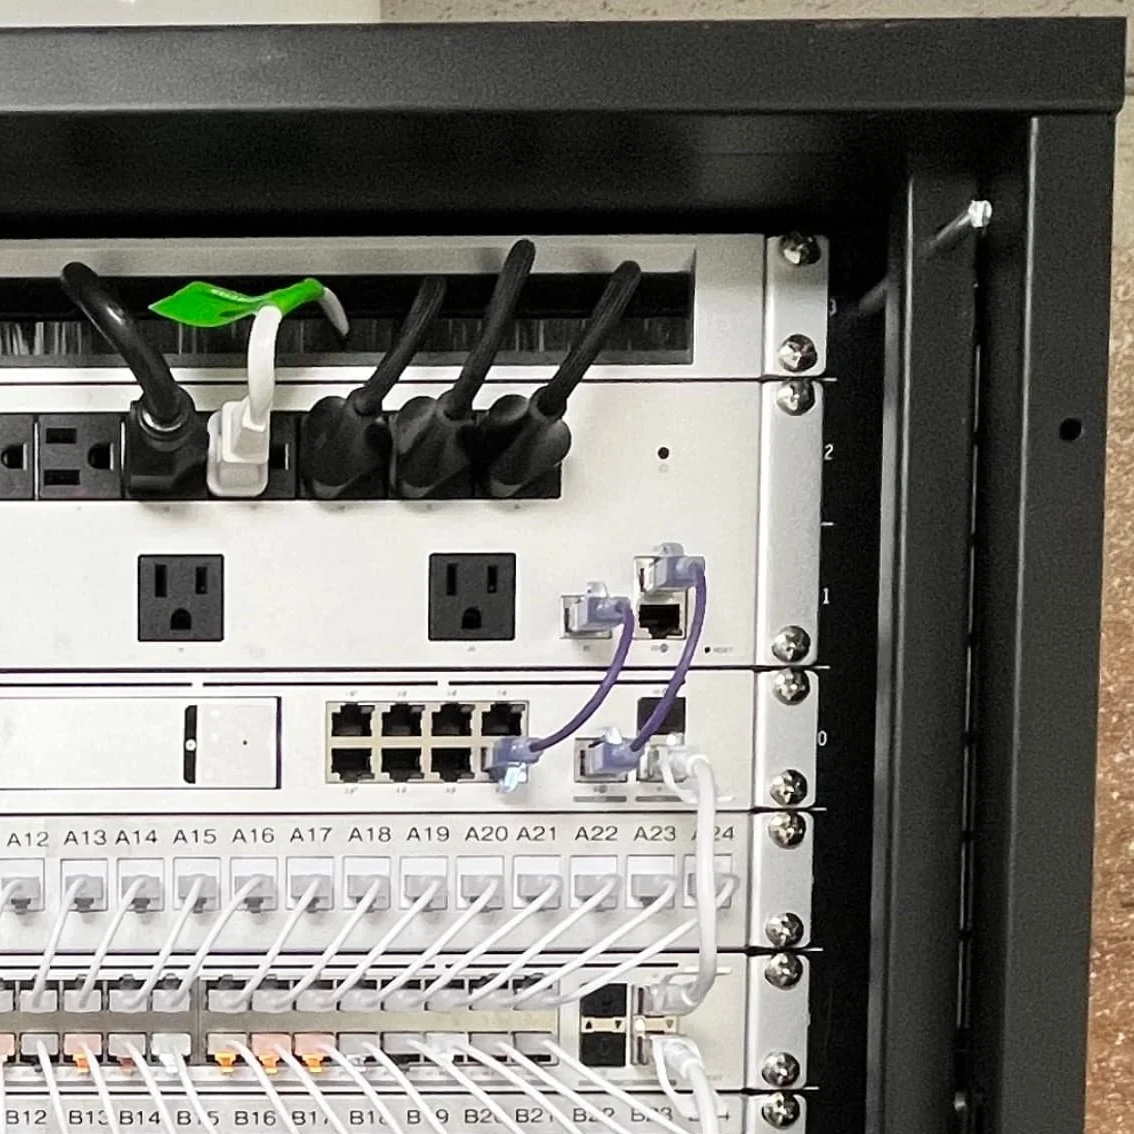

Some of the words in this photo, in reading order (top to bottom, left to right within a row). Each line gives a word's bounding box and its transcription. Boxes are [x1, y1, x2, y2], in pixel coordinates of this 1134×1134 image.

[823, 443, 834, 461] 2
[822, 587, 831, 605] 1
[6, 831, 50, 848] A12
[63, 828, 108, 846] A13
[114, 829, 158, 846] A14
[172, 828, 217, 845] A15
[231, 826, 275, 844] A16
[289, 826, 333, 843] A17
[347, 826, 392, 843] A18
[406, 825, 450, 843] A19
[464, 825, 509, 842] A20
[516, 825, 558, 842] A21
[574, 825, 618, 842] A22
[633, 825, 677, 842] A23
[5, 1109, 48, 1126] B12
[118, 1109, 161, 1126] B14
[234, 1109, 277, 1127] B16
[291, 1109, 331, 1126] B1
[406, 1108, 450, 1125] B9
[630, 1106, 674, 1123] B3
